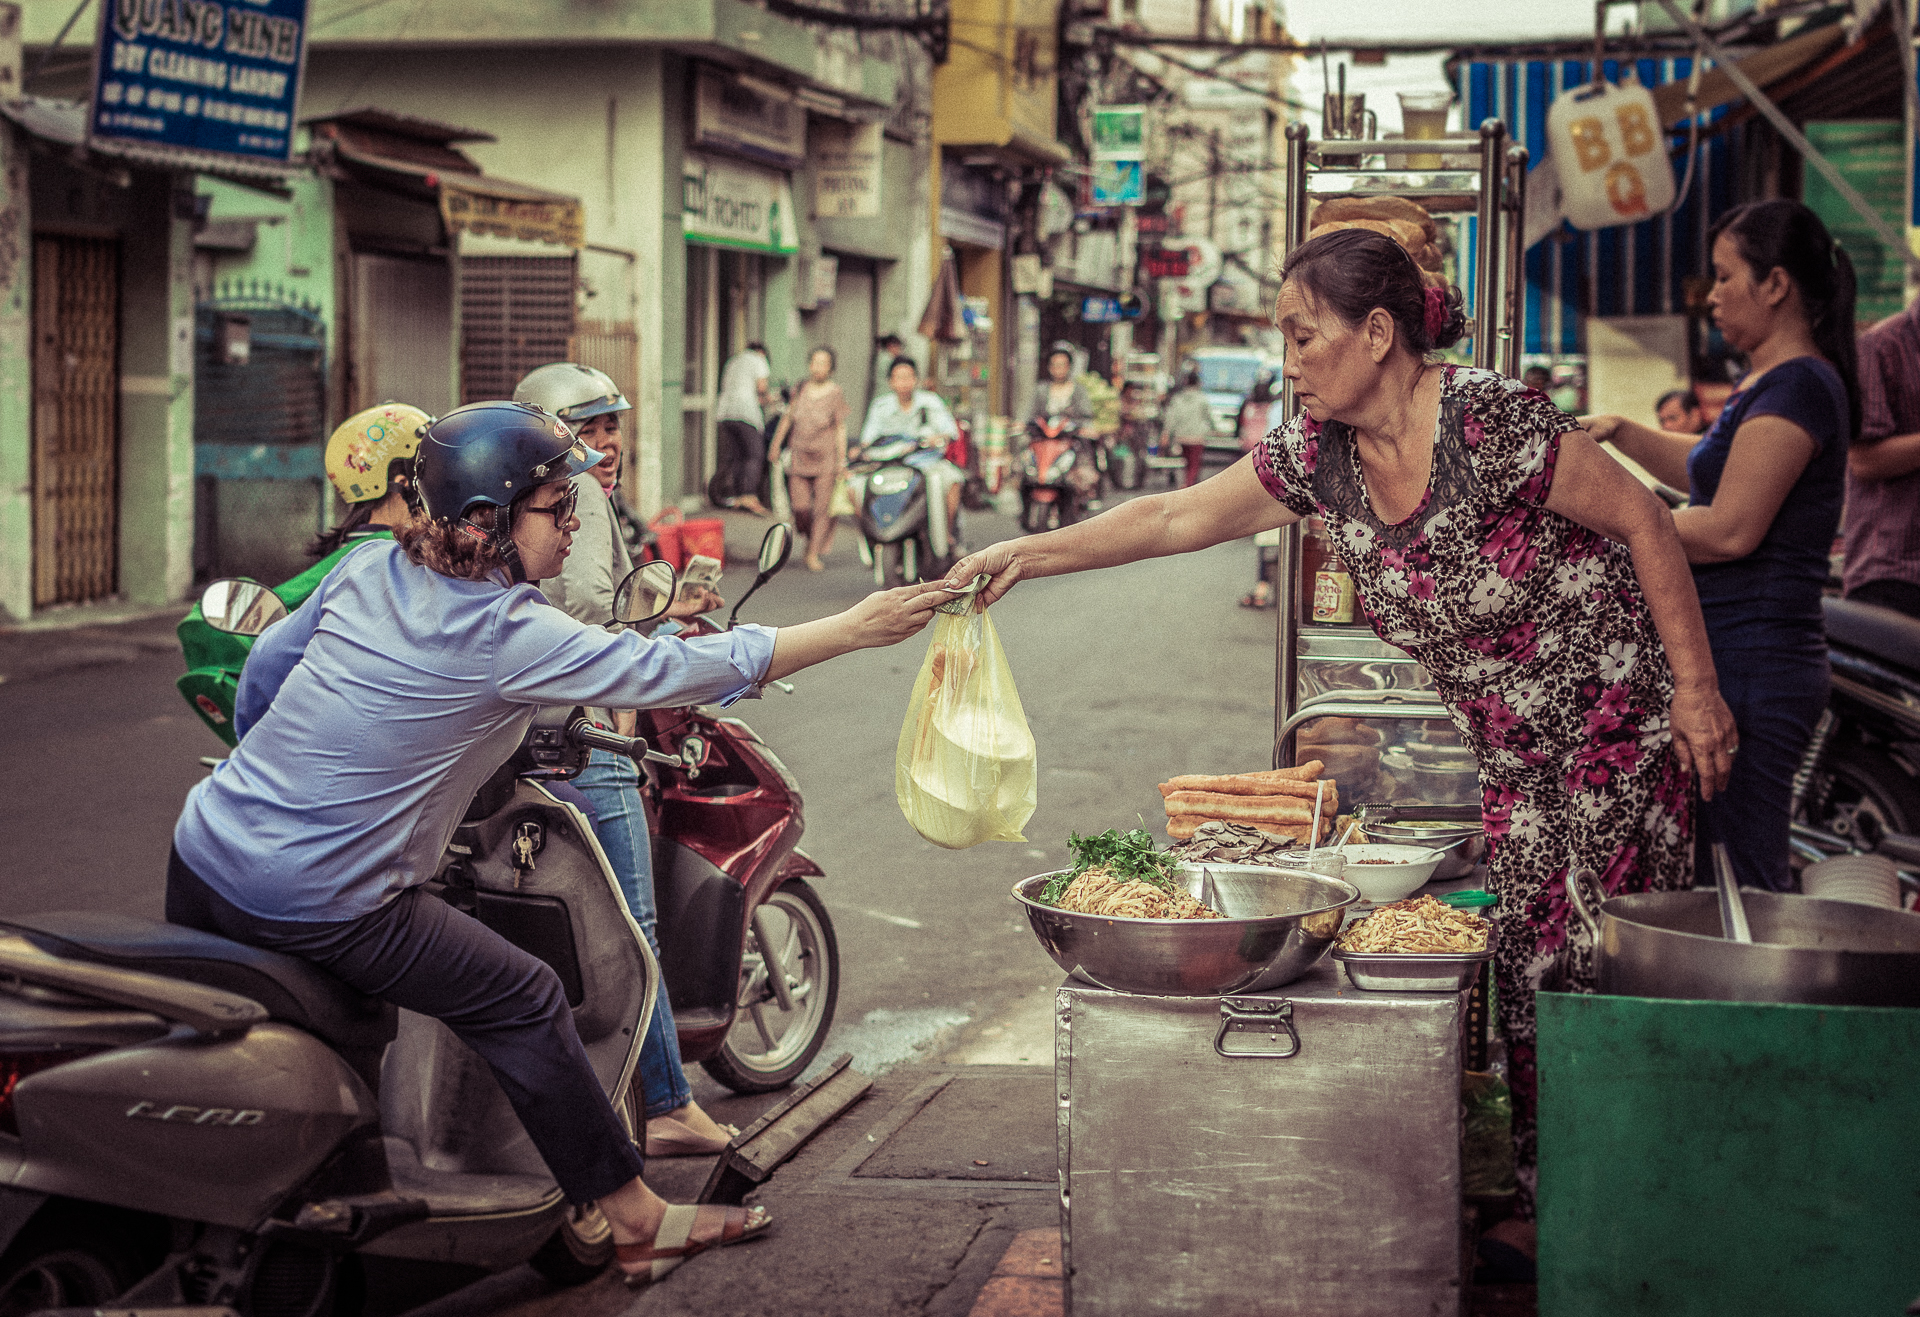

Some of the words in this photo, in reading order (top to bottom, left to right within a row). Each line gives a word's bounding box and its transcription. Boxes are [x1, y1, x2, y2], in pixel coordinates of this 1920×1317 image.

[115, 0, 224, 48] QUANG
[224, 6, 300, 65] MINH
[112, 42, 148, 73] DRY
[366, 423, 407, 465] SAFETY
[126, 1100, 266, 1126] LEAD
